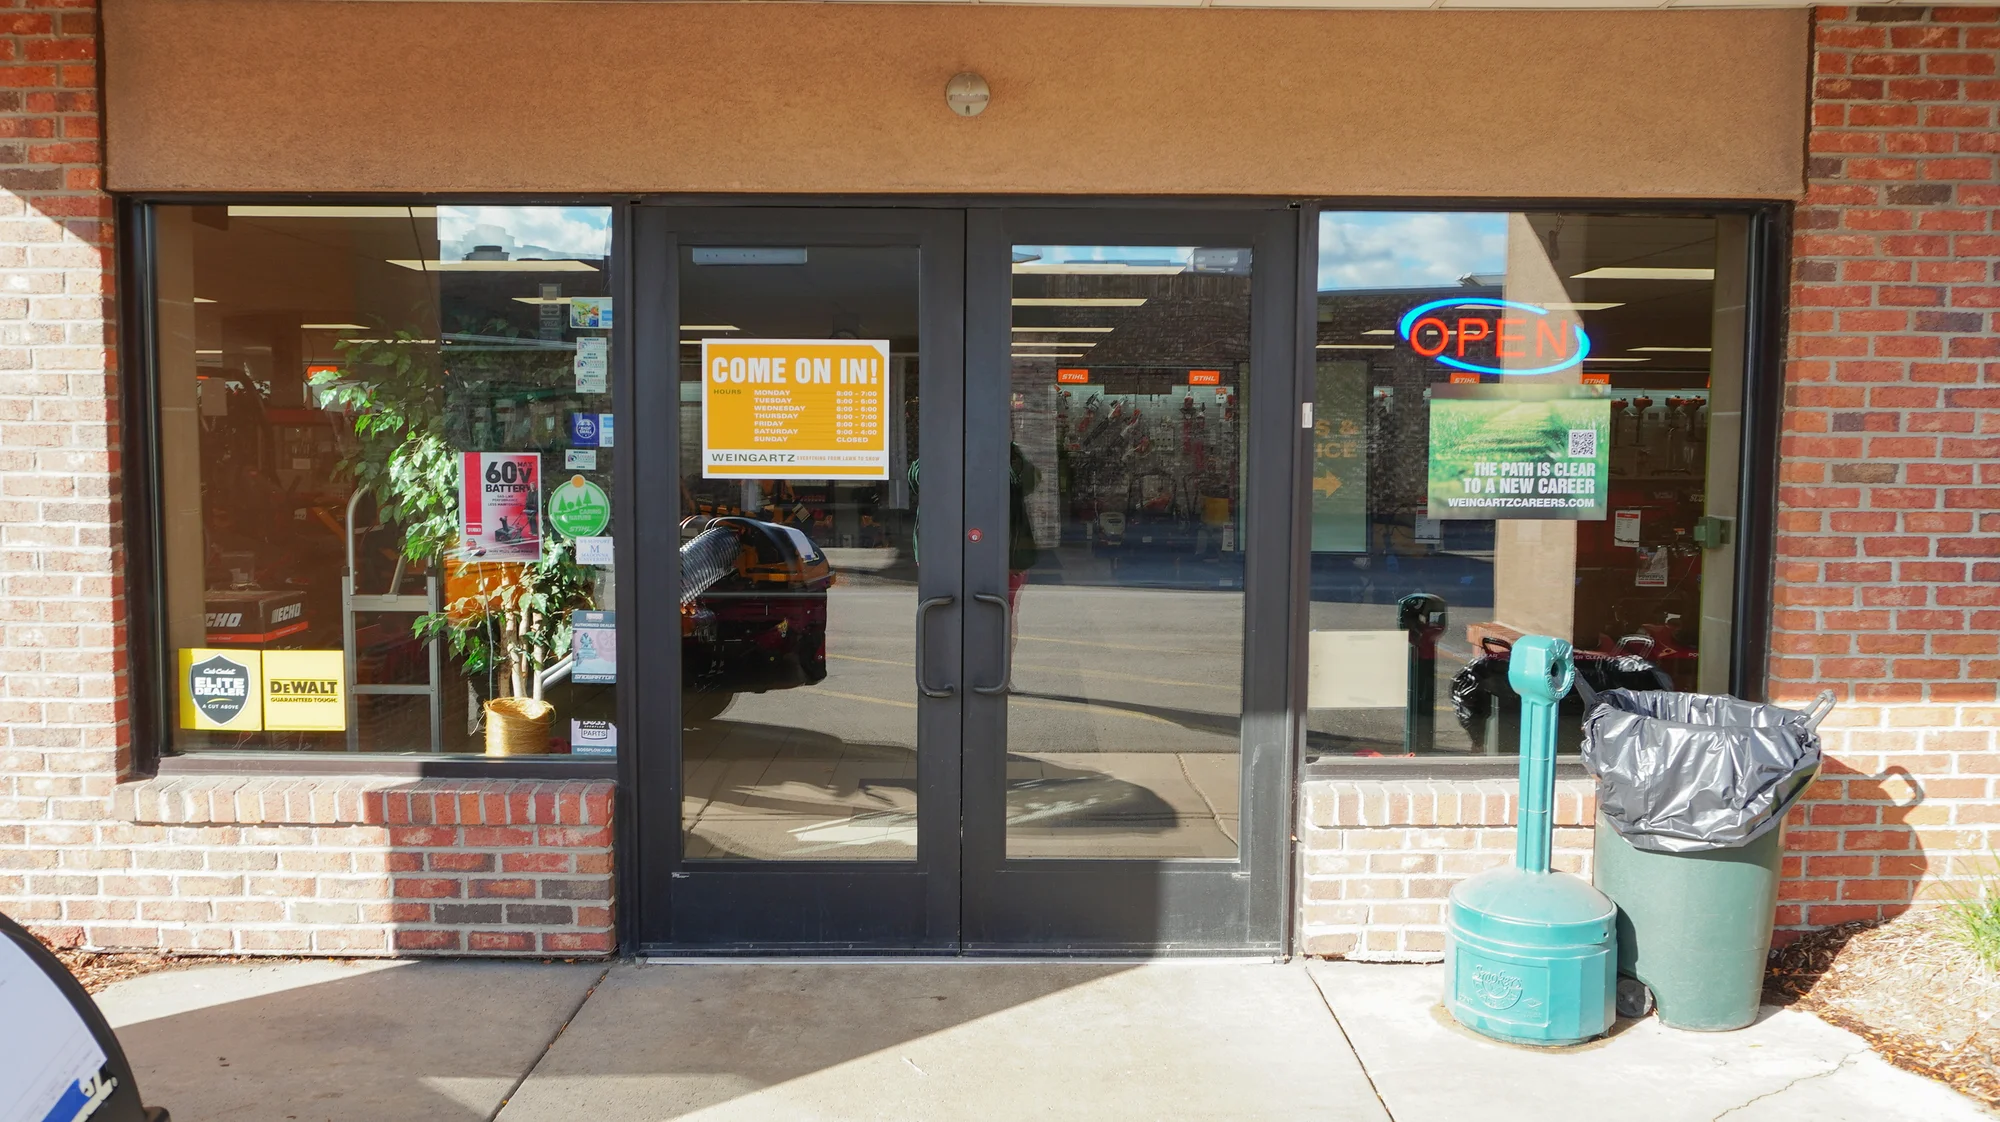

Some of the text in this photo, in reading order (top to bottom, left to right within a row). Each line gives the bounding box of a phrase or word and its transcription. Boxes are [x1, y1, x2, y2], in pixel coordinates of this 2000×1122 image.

[1410, 318, 1568, 357] OPEN
[712, 357, 878, 384] COME ON IN!
[712, 454, 796, 462] WEINGARTZ
[1474, 462, 1595, 476] THE PATH IS CLEAR
[486, 484, 532, 492] BATTERY
[1463, 478, 1595, 494] TO A NEW CAREER
[1448, 498, 1594, 508] WEINGARTZCAREERS.COM
[279, 602, 301, 621] ECHO
[194, 677, 244, 689] ELITE
[194, 687, 245, 696] DEALER
